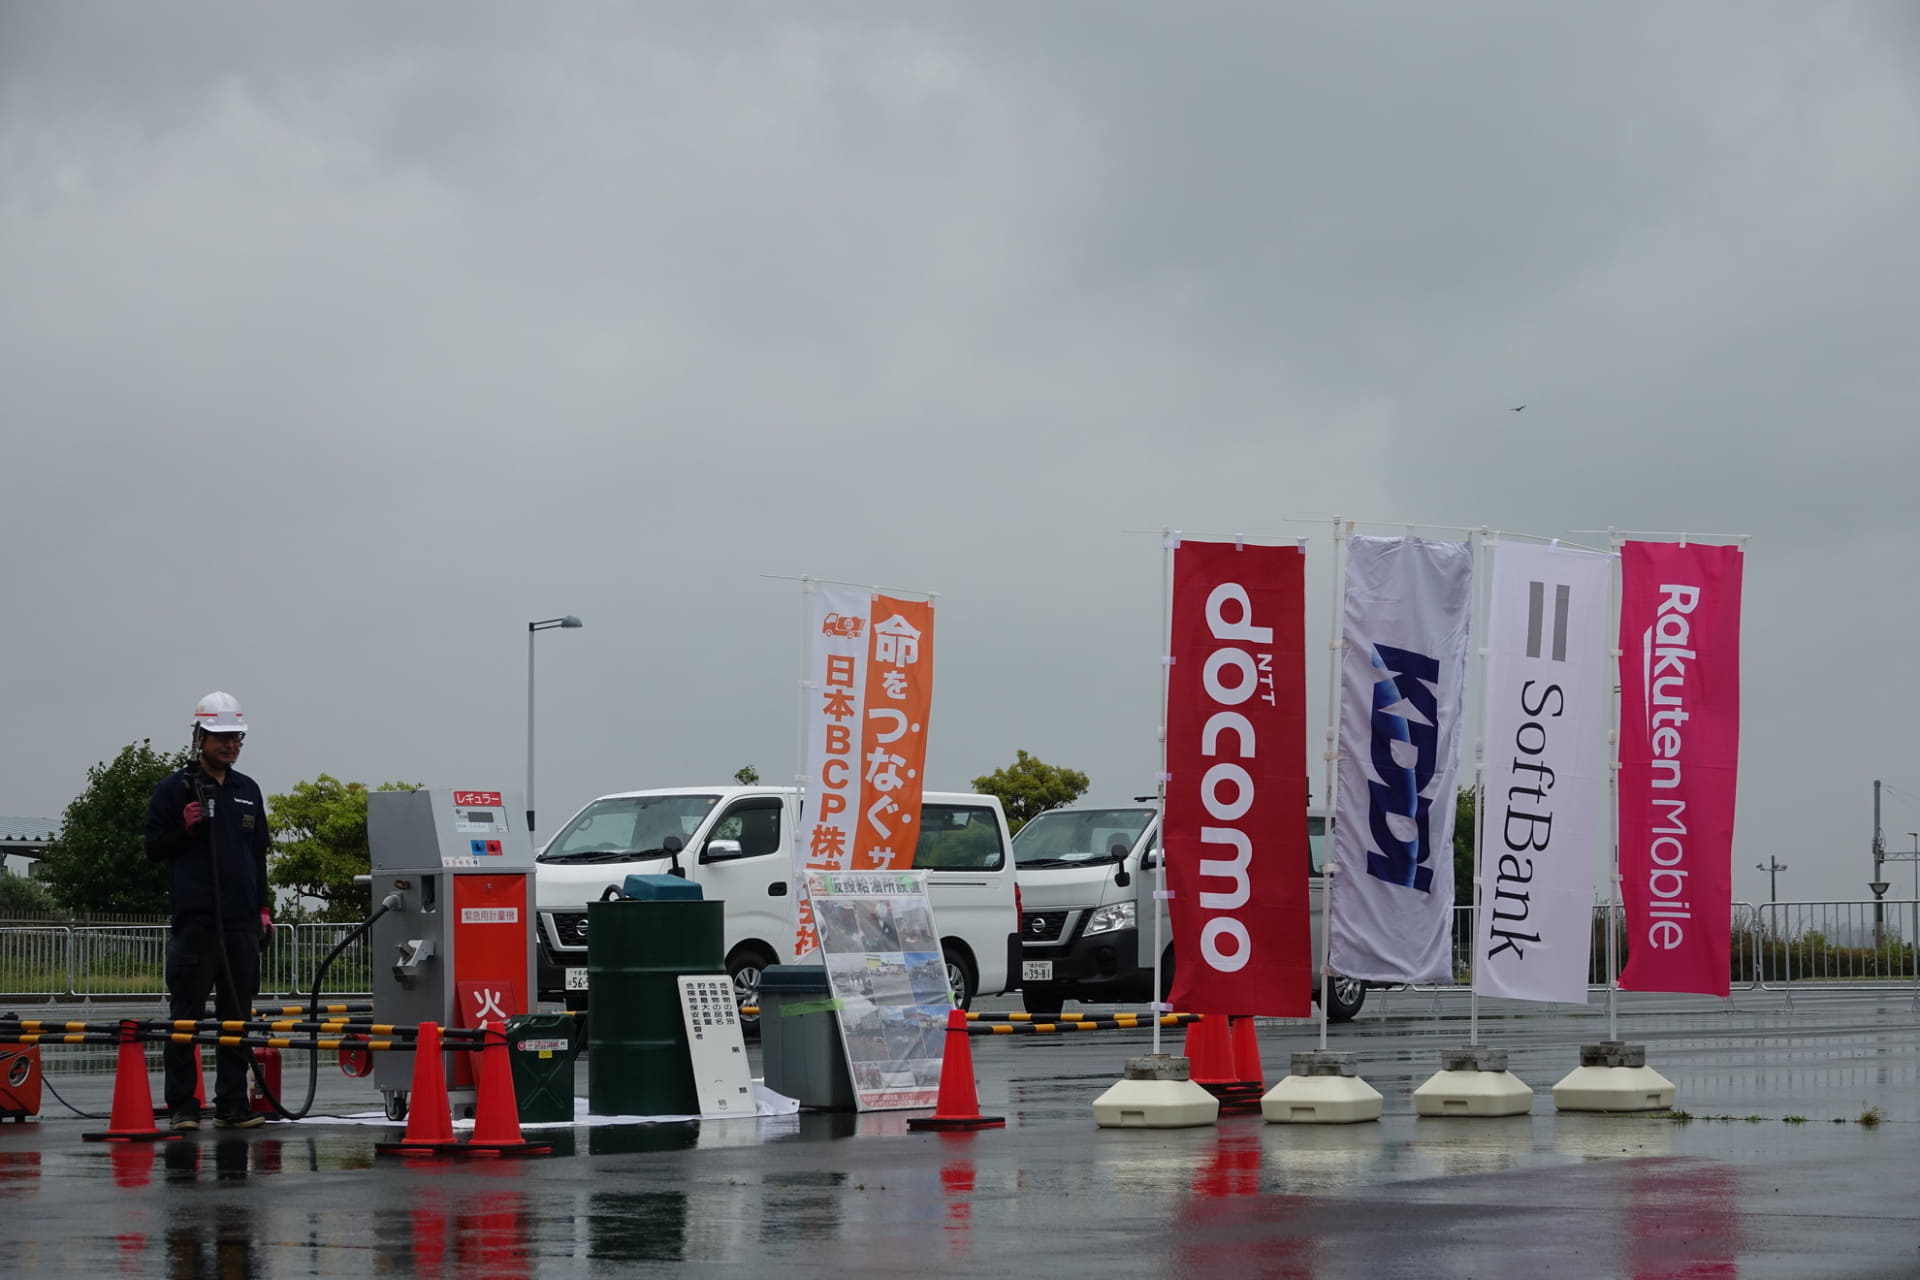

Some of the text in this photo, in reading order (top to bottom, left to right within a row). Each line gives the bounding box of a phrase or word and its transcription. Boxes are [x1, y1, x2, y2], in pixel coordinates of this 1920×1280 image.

[456, 792, 500, 804] レギュラー
[1200, 582, 1274, 972] docomo
[1256, 653, 1276, 706] NTT
[1366, 642, 1440, 894] KDDI
[1647, 583, 1701, 950] Rakuten Mobile
[1487, 679, 1564, 961] SoftBank
[472, 987, 507, 1031] 火
